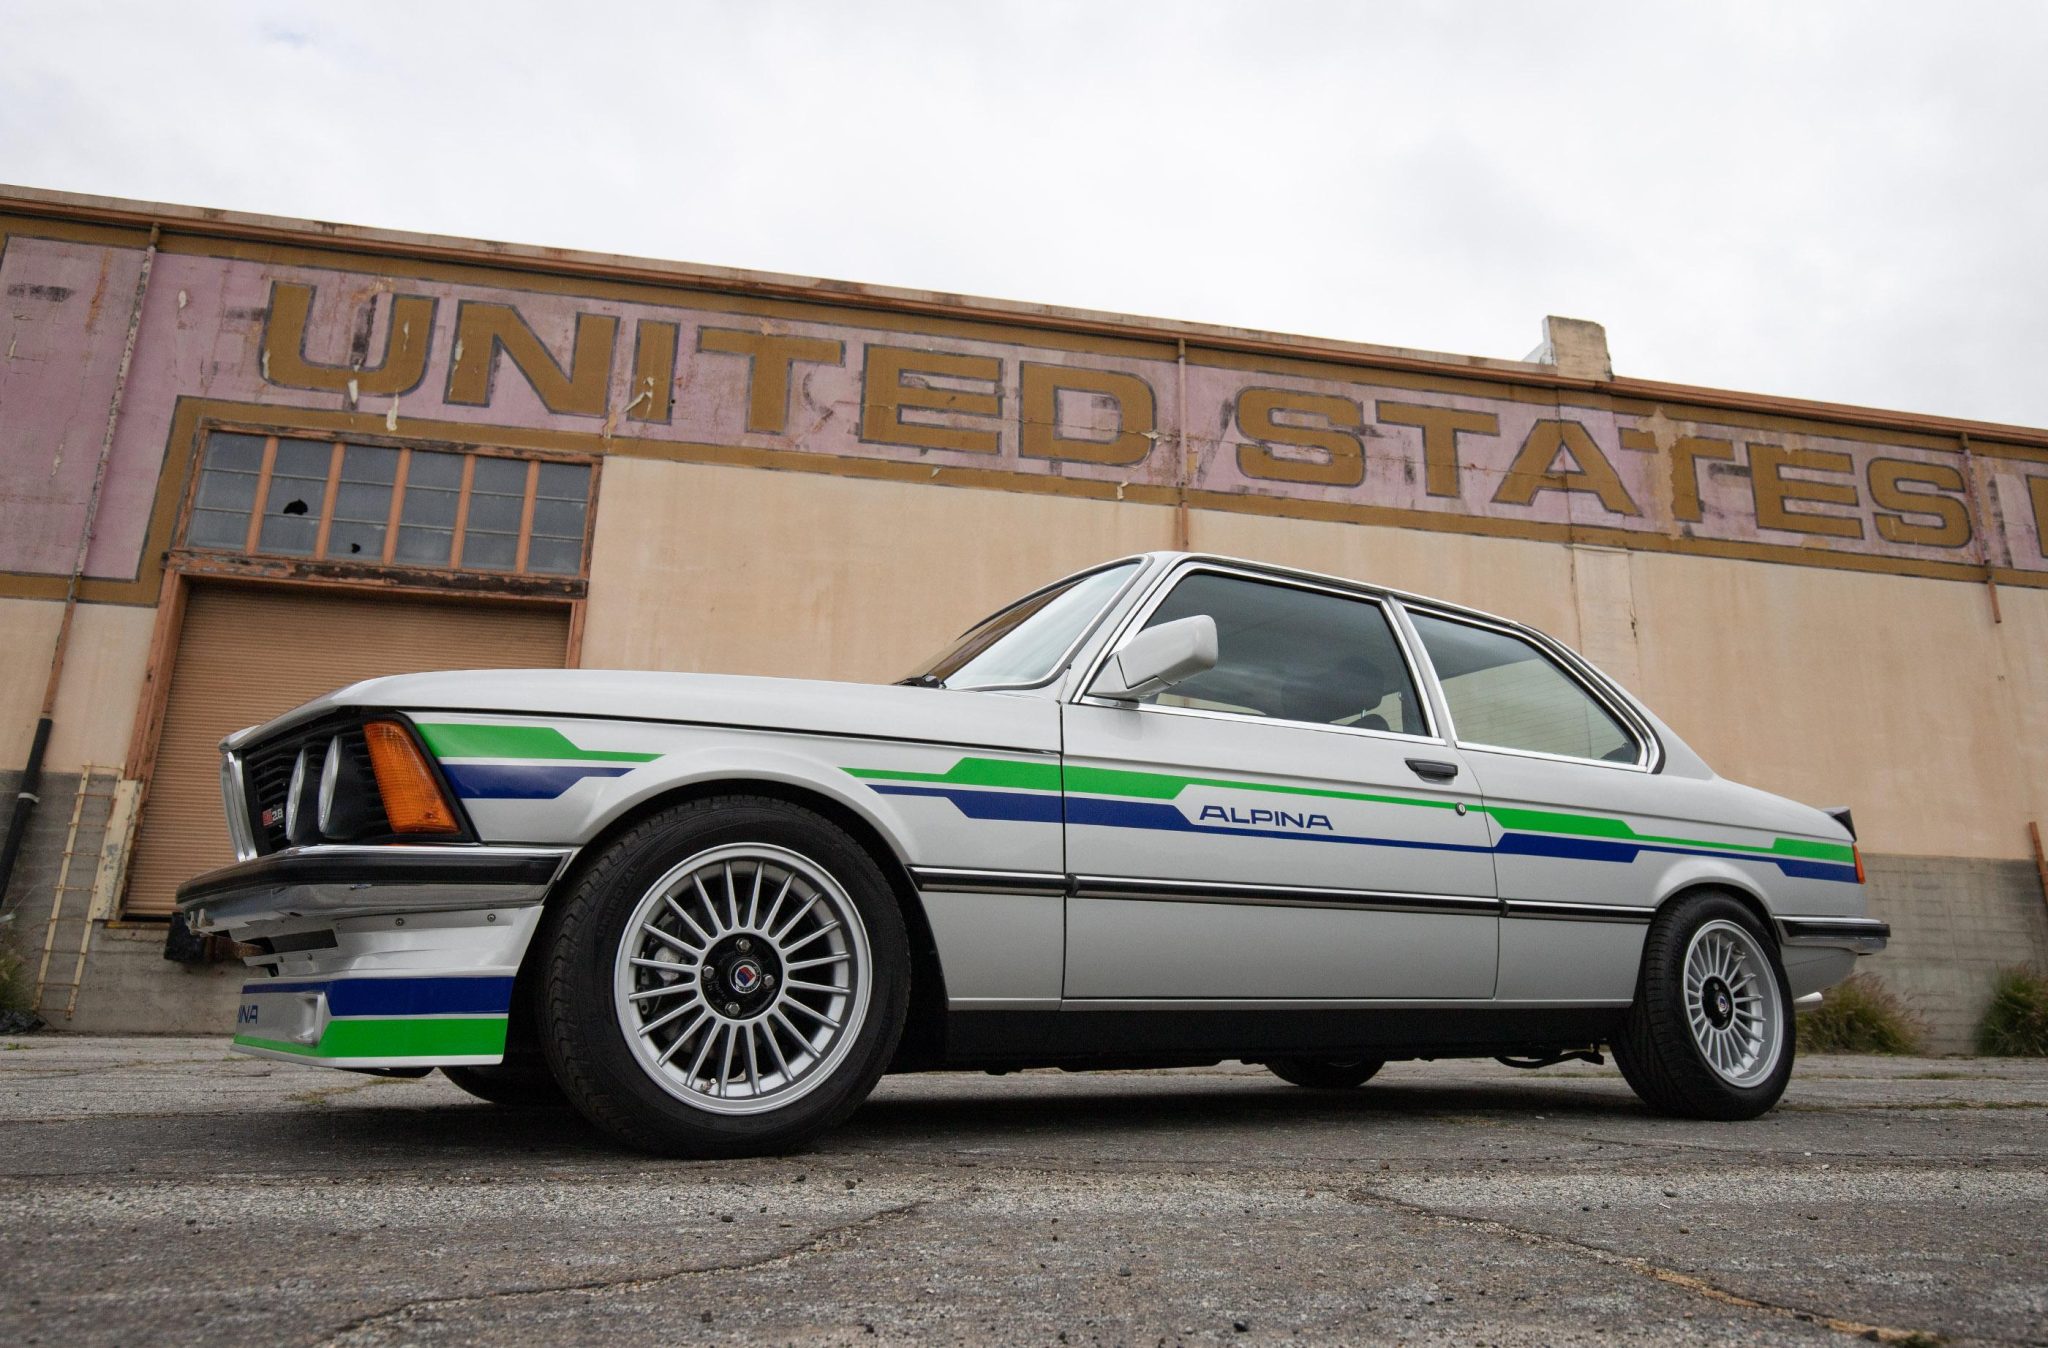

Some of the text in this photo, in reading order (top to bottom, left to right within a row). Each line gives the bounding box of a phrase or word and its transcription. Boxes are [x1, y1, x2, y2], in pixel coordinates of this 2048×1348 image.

[258, 280, 1158, 467] UNITED
[1234, 385, 1974, 549] STATES
[1199, 805, 1334, 831] ALPINA
